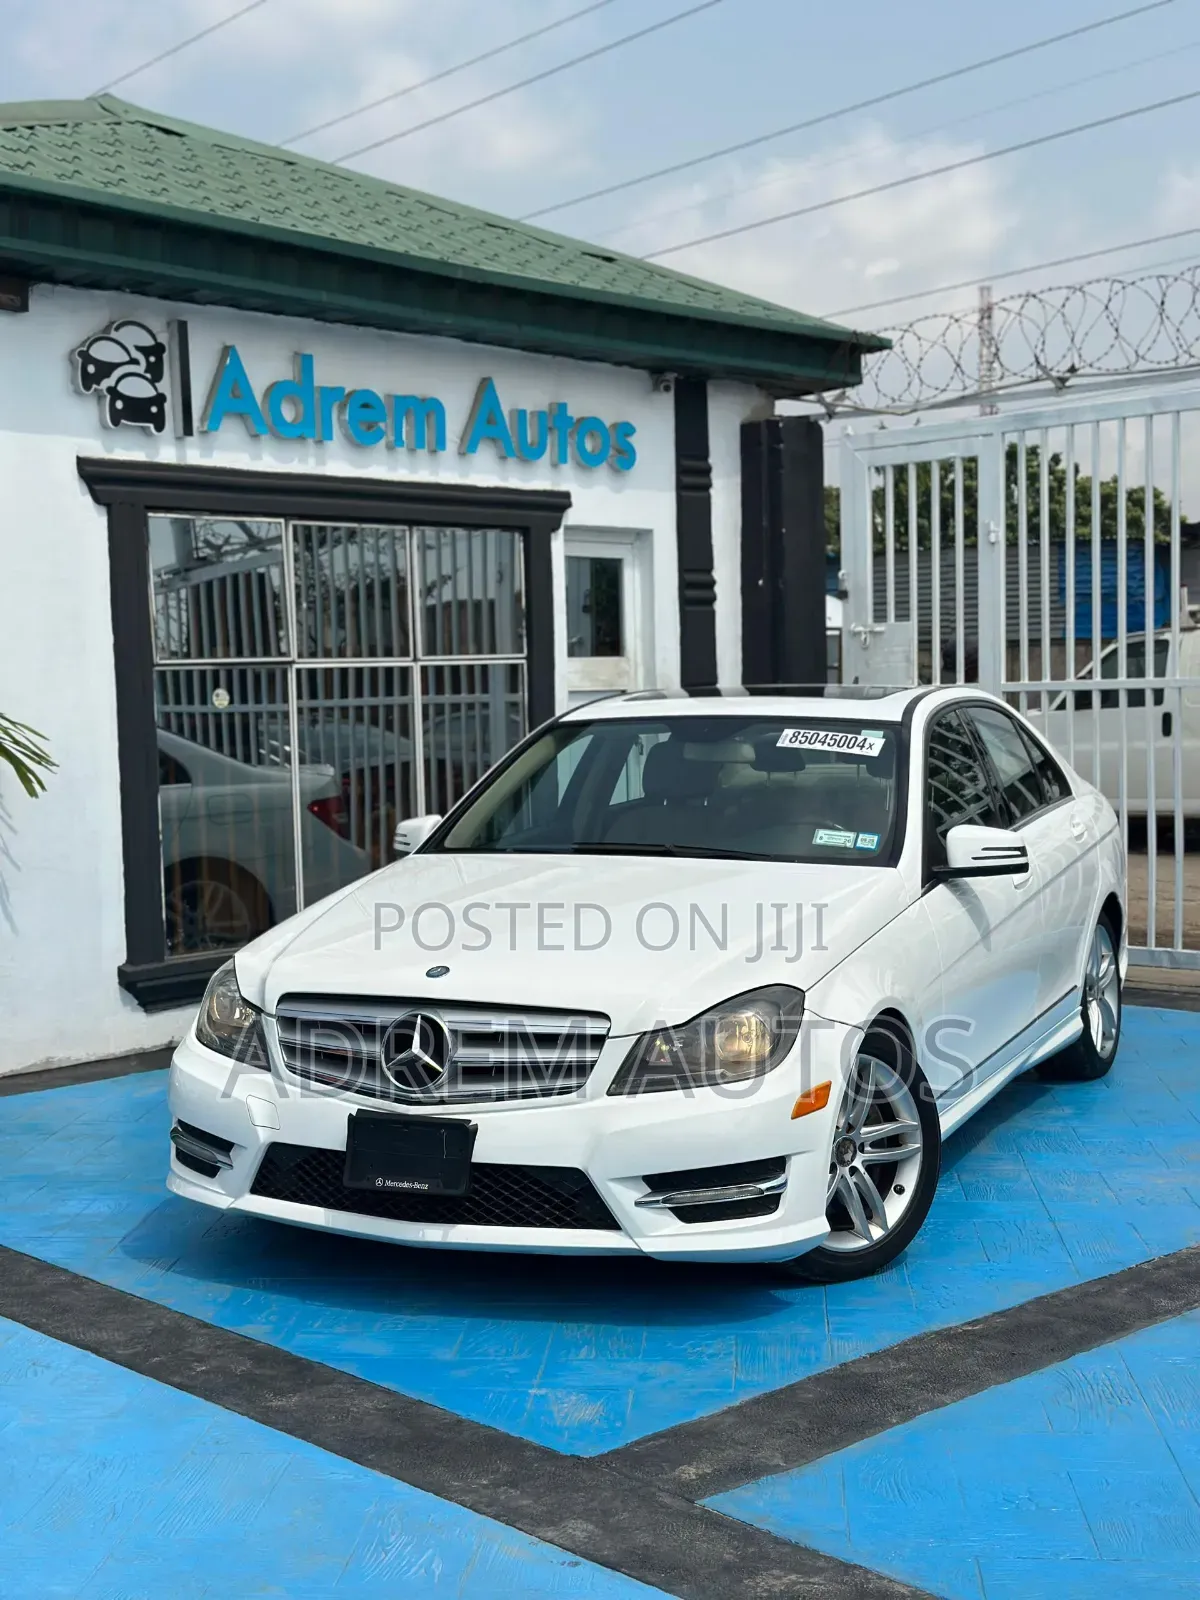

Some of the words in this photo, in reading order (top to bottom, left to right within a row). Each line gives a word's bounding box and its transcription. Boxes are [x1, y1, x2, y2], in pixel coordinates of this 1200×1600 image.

[202, 344, 446, 452] Adrem
[460, 376, 637, 472] Autos
[384, 1179, 429, 1190] Mercedes-Benz
